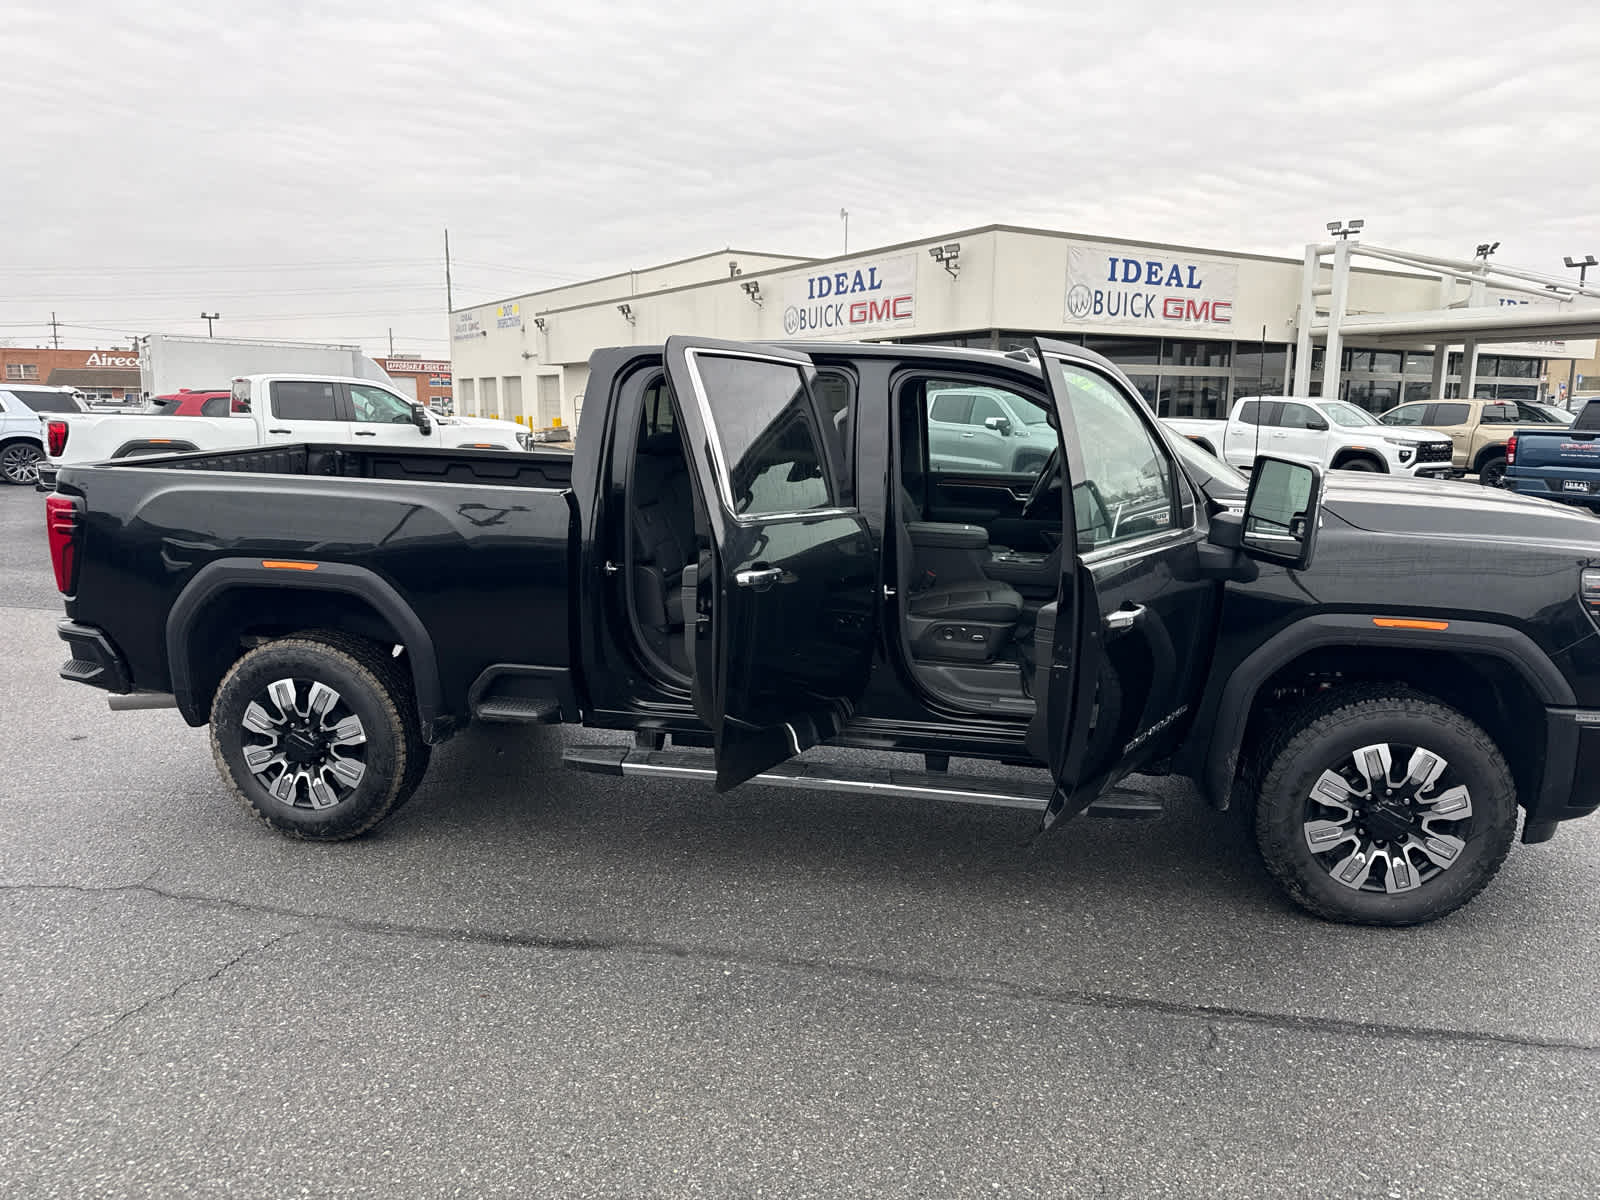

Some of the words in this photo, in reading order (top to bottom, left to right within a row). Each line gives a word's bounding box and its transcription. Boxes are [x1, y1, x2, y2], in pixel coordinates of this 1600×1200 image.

[808, 267, 882, 299] IDEAL
[1107, 257, 1202, 289] IDEAL
[800, 303, 843, 329] BUICK
[849, 295, 912, 323] GMC
[1093, 290, 1156, 319] BUICK
[1163, 297, 1232, 324] GMC
